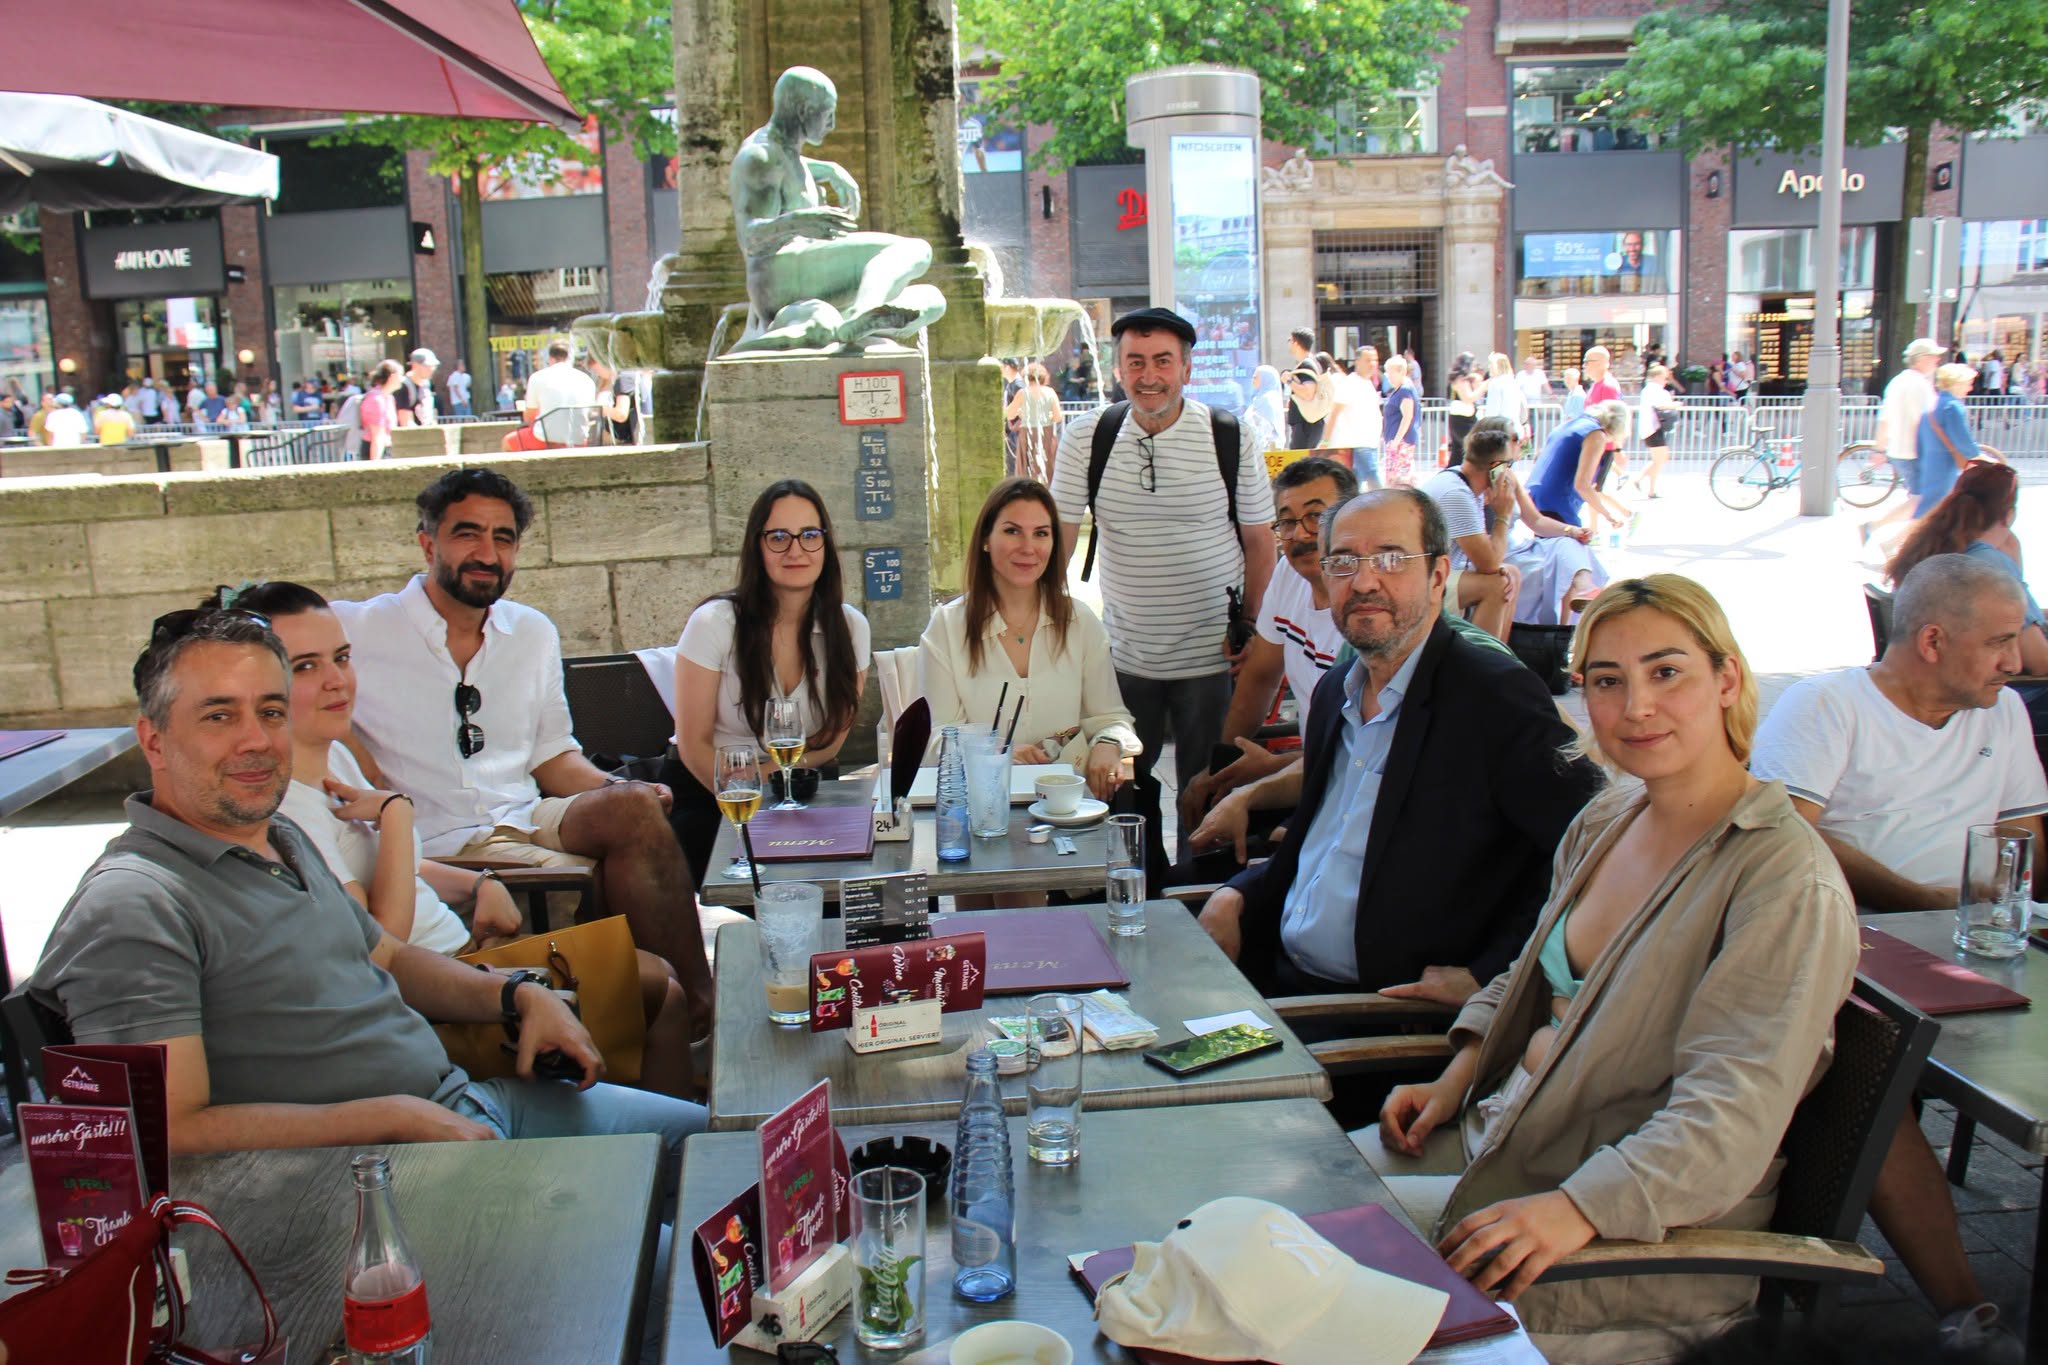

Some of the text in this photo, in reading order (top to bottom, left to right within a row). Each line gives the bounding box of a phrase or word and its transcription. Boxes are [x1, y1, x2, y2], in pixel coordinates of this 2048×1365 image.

[1777, 168, 1865, 199] Apolo
[489, 336, 517, 352] YOU
[1217, 338, 1239, 349] und
[1191, 355, 1229, 366] orgen:
[1190, 368, 1233, 379] riathlon
[865, 476, 875, 488] S
[865, 556, 875, 569] S
[875, 820, 892, 833] 24
[768, 838, 836, 847] Menu
[892, 945, 907, 982] Wine
[879, 1020, 907, 1028] ORIGINAL
[857, 1031, 940, 1049] HIER ORIGINAL SERVIERT
[62, 1077, 99, 1093] GETRÄNKE
[31, 1119, 127, 1151] unsere Gäste!!!
[84, 1210, 133, 1236] Thank
[757, 1313, 783, 1336] 46
